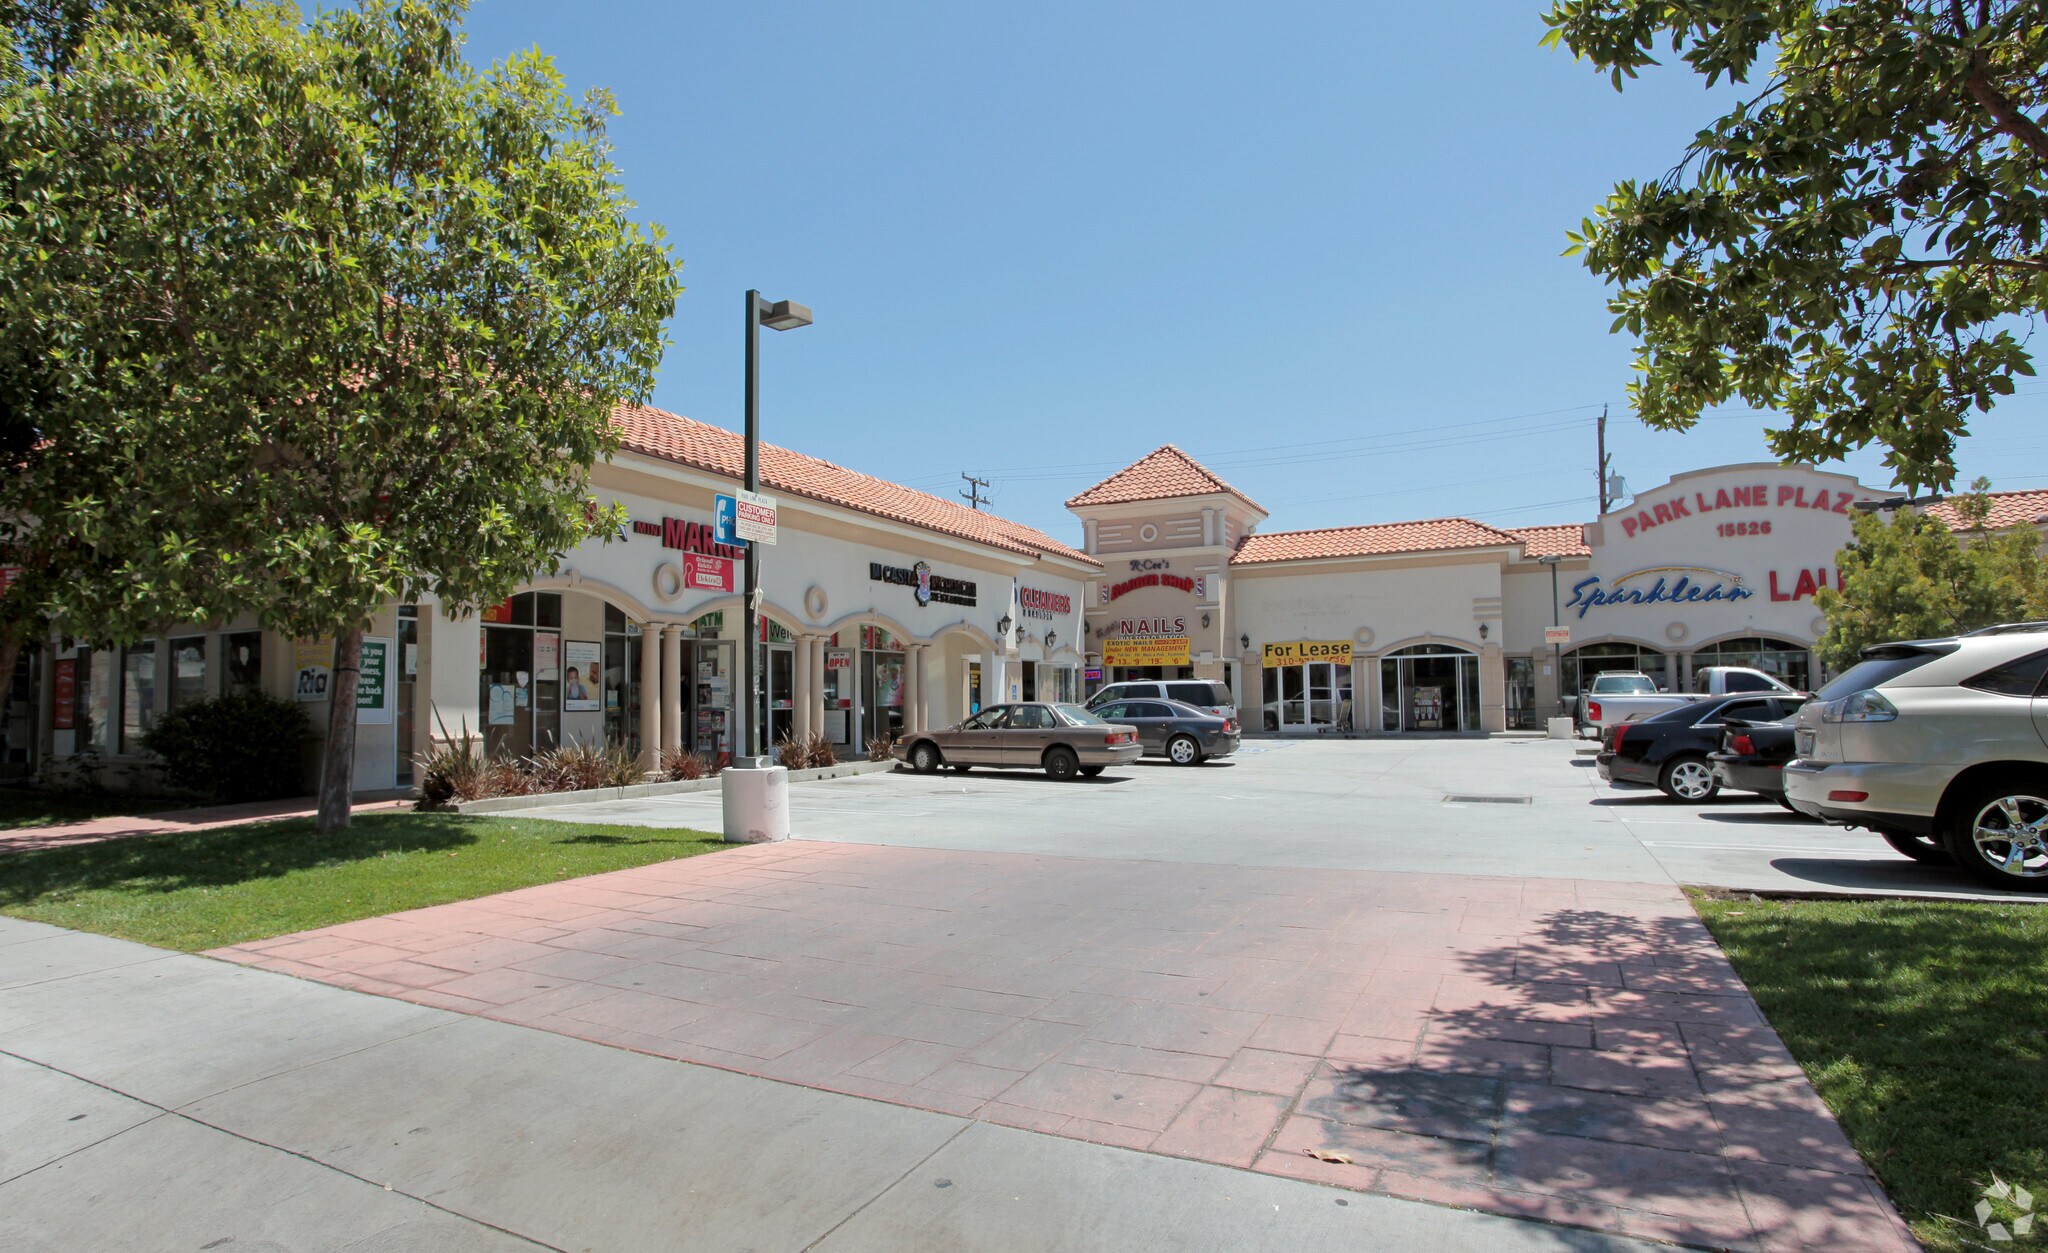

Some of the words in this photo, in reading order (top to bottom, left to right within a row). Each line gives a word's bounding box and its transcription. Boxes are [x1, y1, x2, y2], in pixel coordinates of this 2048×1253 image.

[738, 502, 775, 519] CUSTOMER
[738, 510, 761, 522] PARKING
[761, 516, 775, 525] ONLY
[1621, 497, 1691, 538] PARK
[1696, 485, 1767, 513] LANE
[1777, 485, 1855, 514] PLAZ
[721, 515, 736, 526] PHO
[634, 520, 661, 537] MINI
[1716, 521, 1772, 538] 15526
[698, 574, 716, 583] Elektra
[1111, 574, 1159, 601] BARBER
[1161, 574, 1194, 593] SHOP
[1020, 587, 1071, 615] CLEANERS
[1566, 575, 1756, 620] Sparklean
[700, 611, 723, 626] ATM
[1120, 617, 1186, 635] NAILS
[371, 647, 383, 657] you
[1265, 644, 1292, 657] For
[1300, 643, 1350, 657] Lease
[364, 657, 379, 667] your
[829, 658, 850, 668] OPEN
[297, 669, 328, 694] Ria
[365, 686, 381, 695] back
[357, 696, 373, 705] oon!
